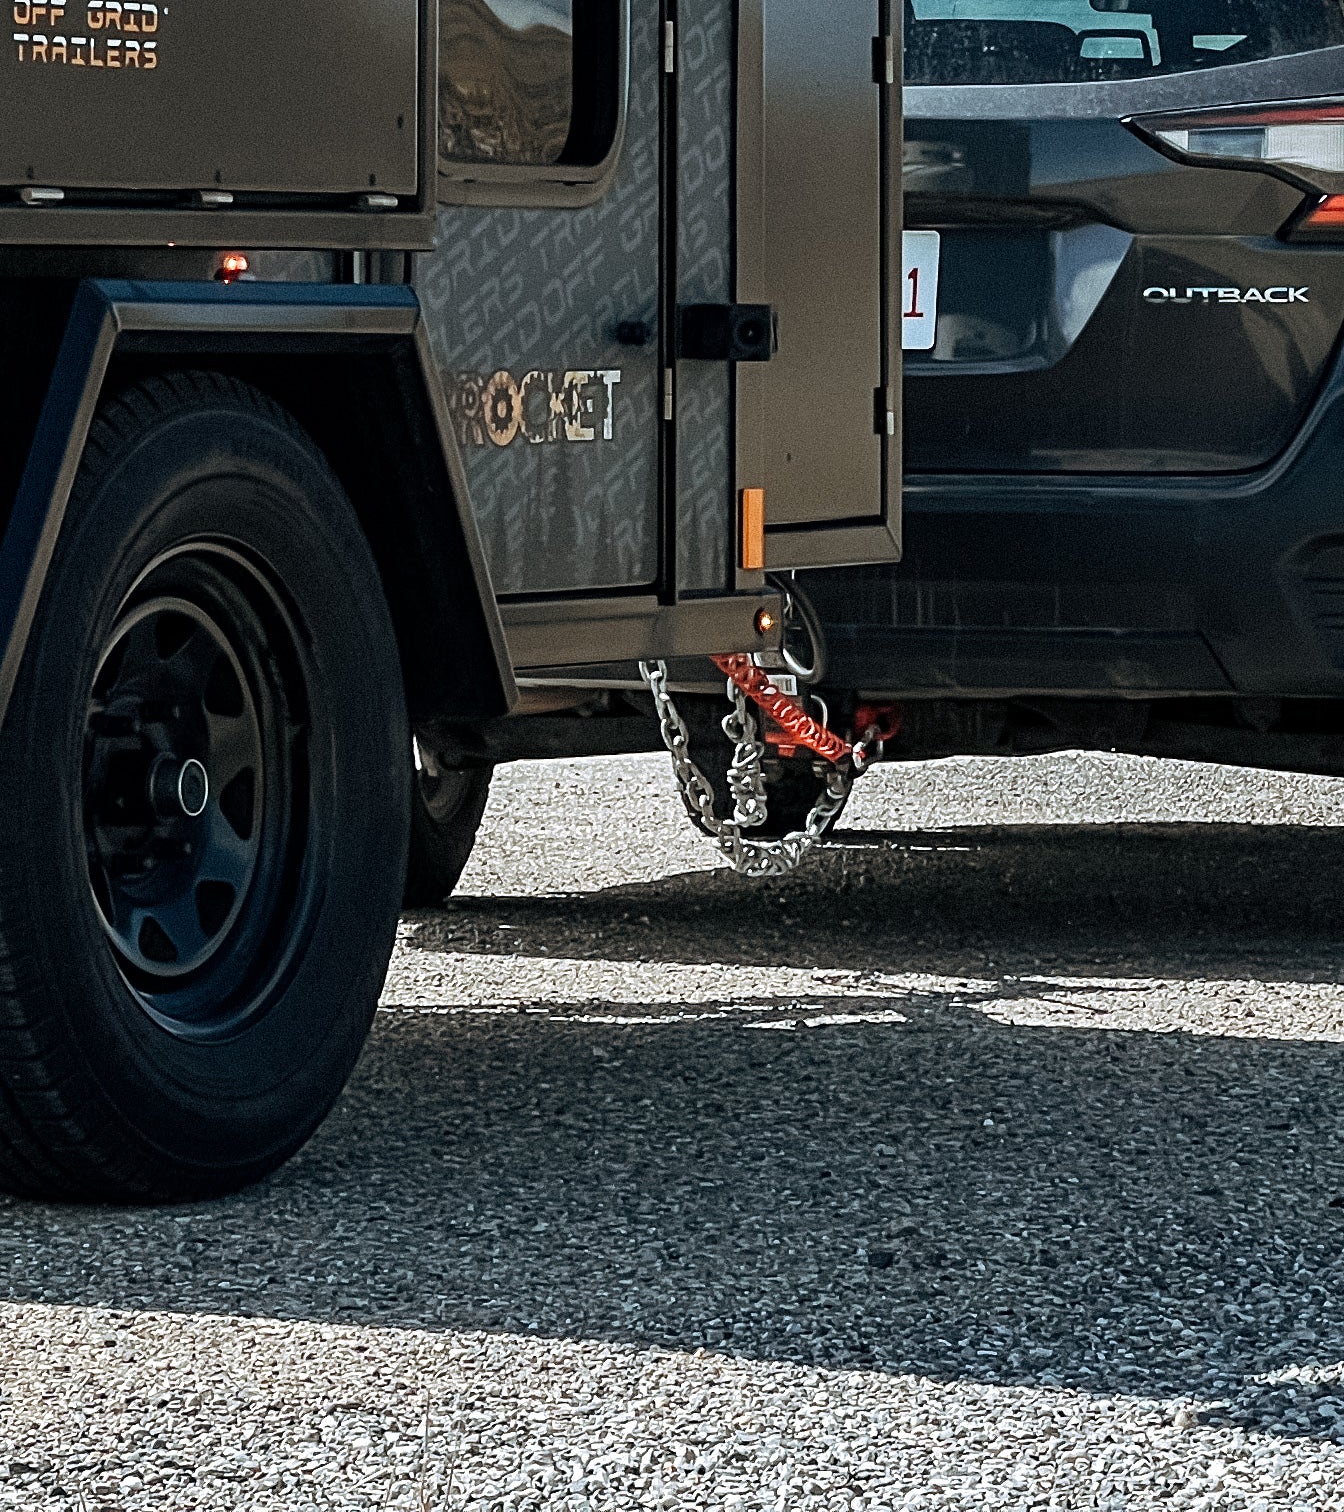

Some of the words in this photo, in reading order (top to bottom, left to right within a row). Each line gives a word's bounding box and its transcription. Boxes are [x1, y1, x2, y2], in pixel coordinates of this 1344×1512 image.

[87, 0, 158, 32] GRID
[13, 33, 157, 69] TRAILERS
[903, 267, 924, 318] 1
[1143, 286, 1310, 304] OUTBACK
